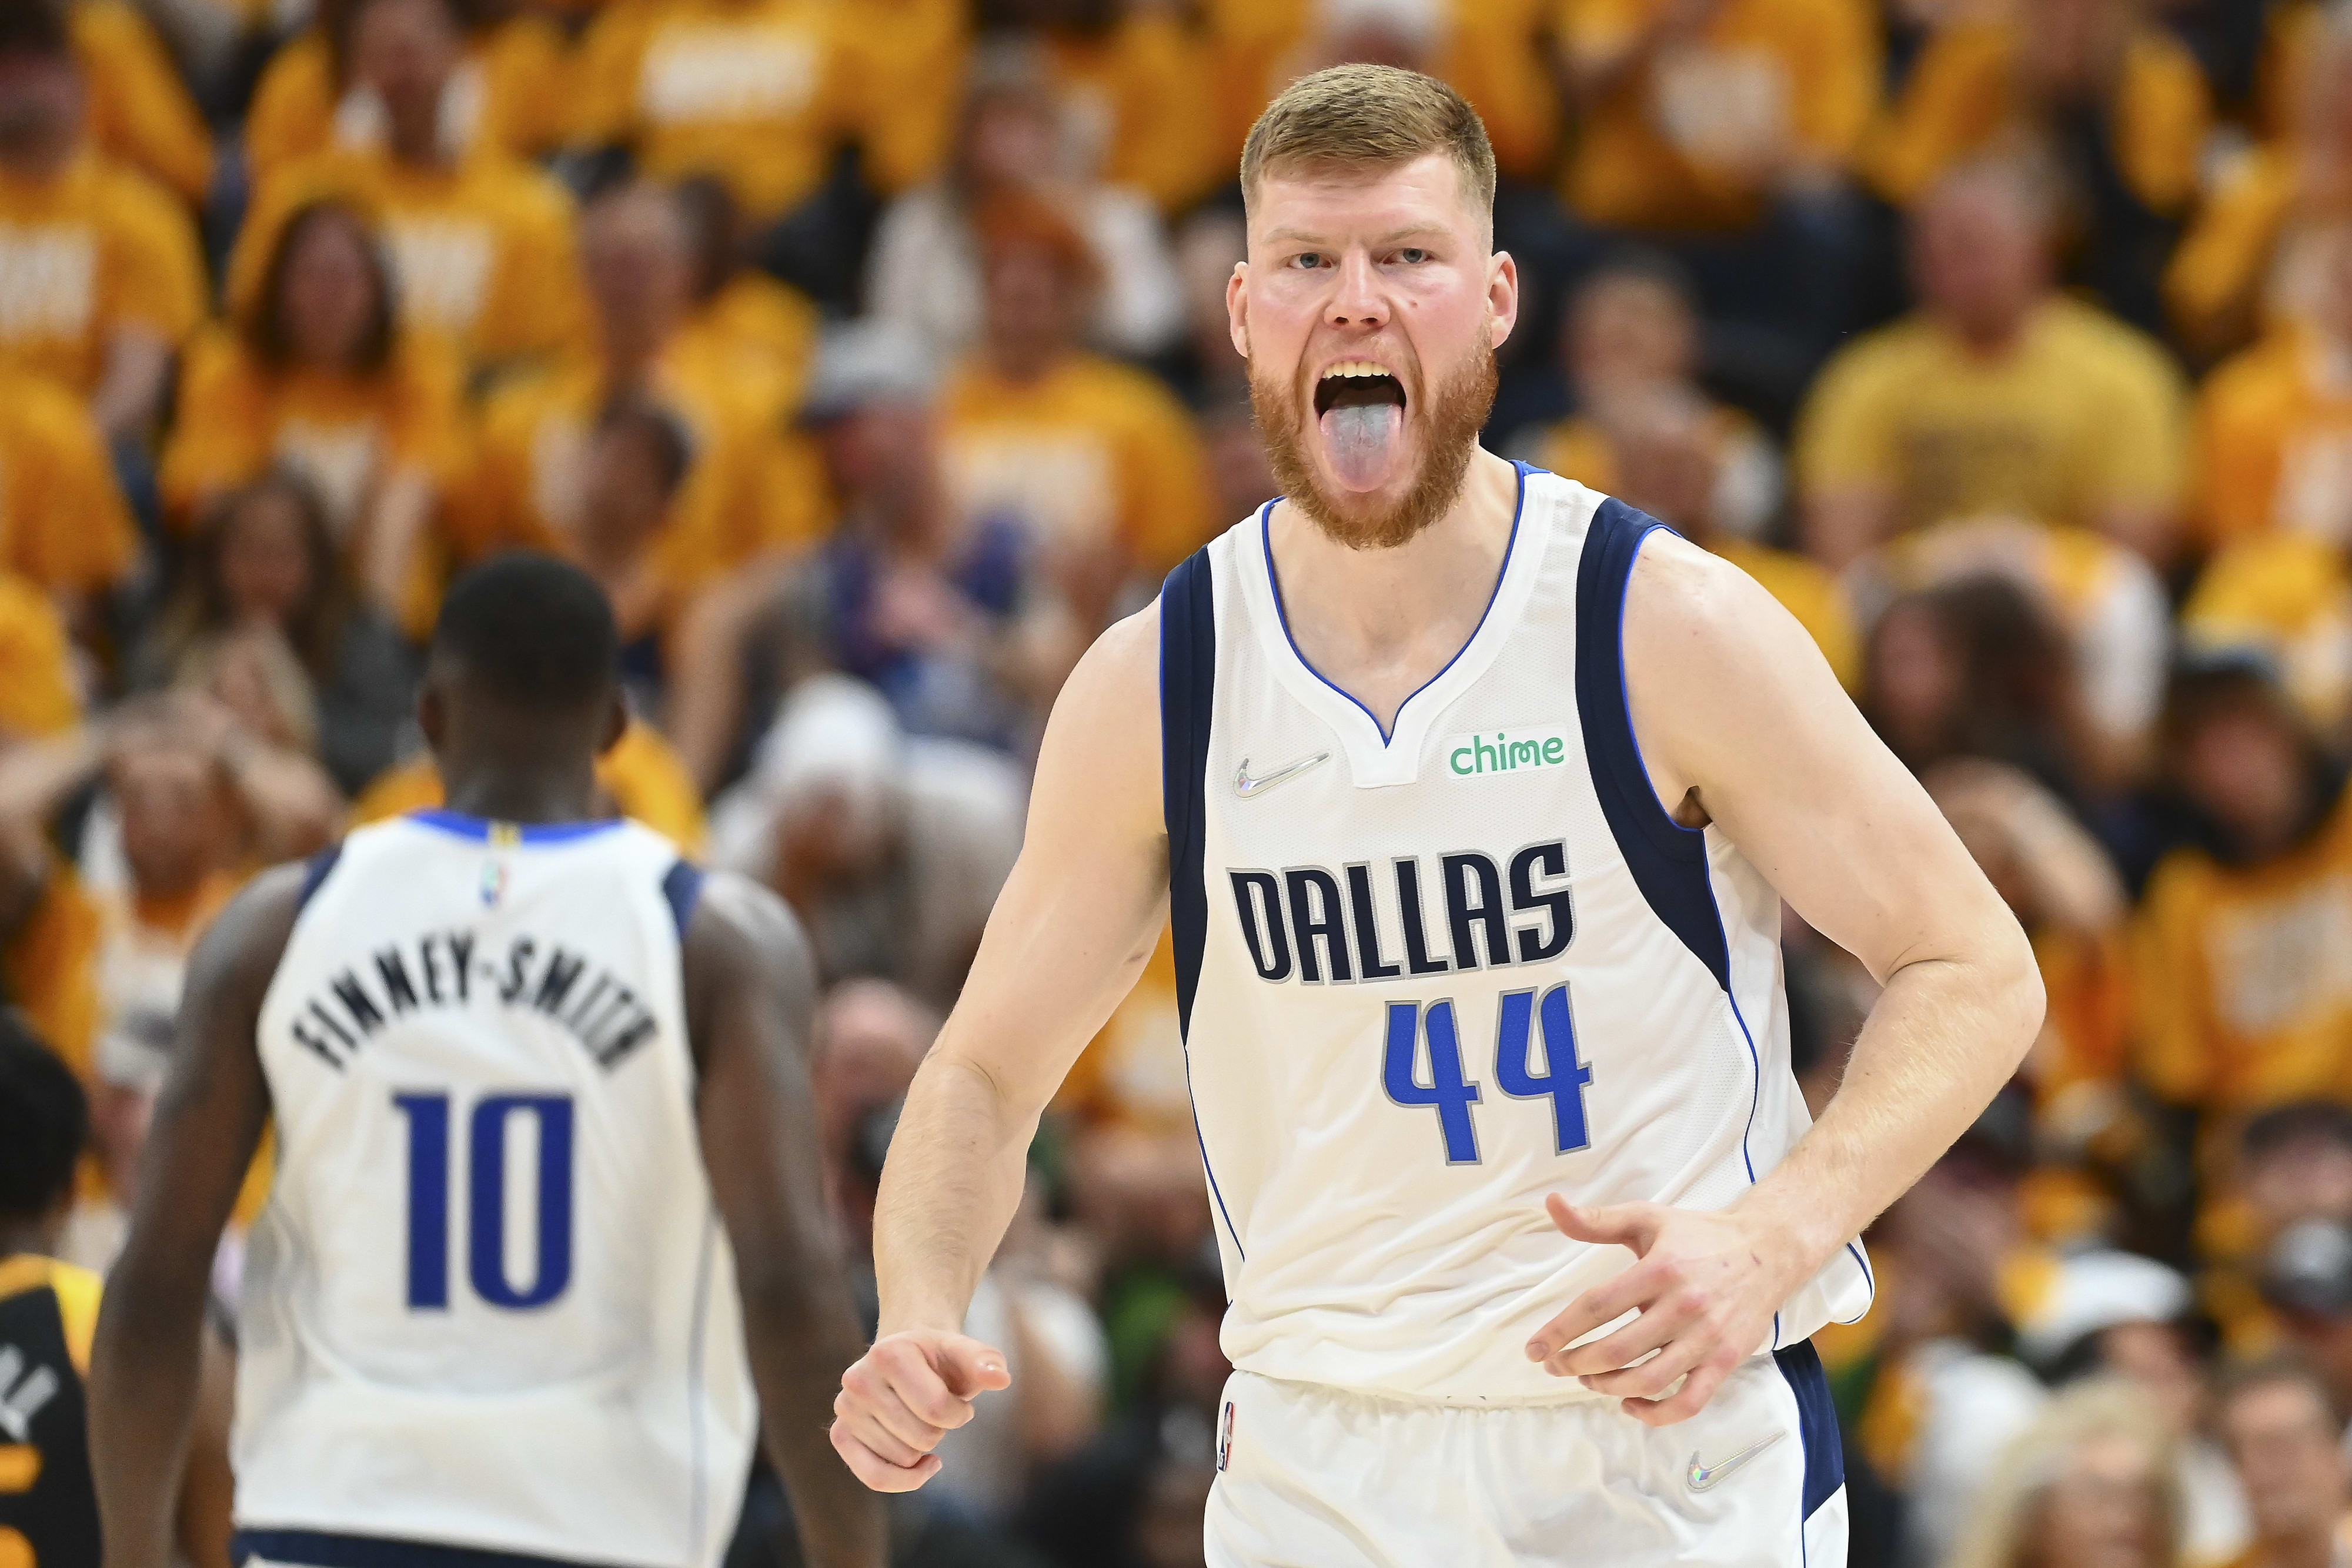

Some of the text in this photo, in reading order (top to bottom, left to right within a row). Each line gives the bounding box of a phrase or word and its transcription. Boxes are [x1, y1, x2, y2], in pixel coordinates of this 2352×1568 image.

[1450, 733, 1565, 775] chime
[1226, 838, 1578, 985] DALLAS
[292, 929, 659, 1071] FINNEY-SMITH
[1381, 981, 1594, 1166] 44
[392, 1091, 575, 1313] 10
